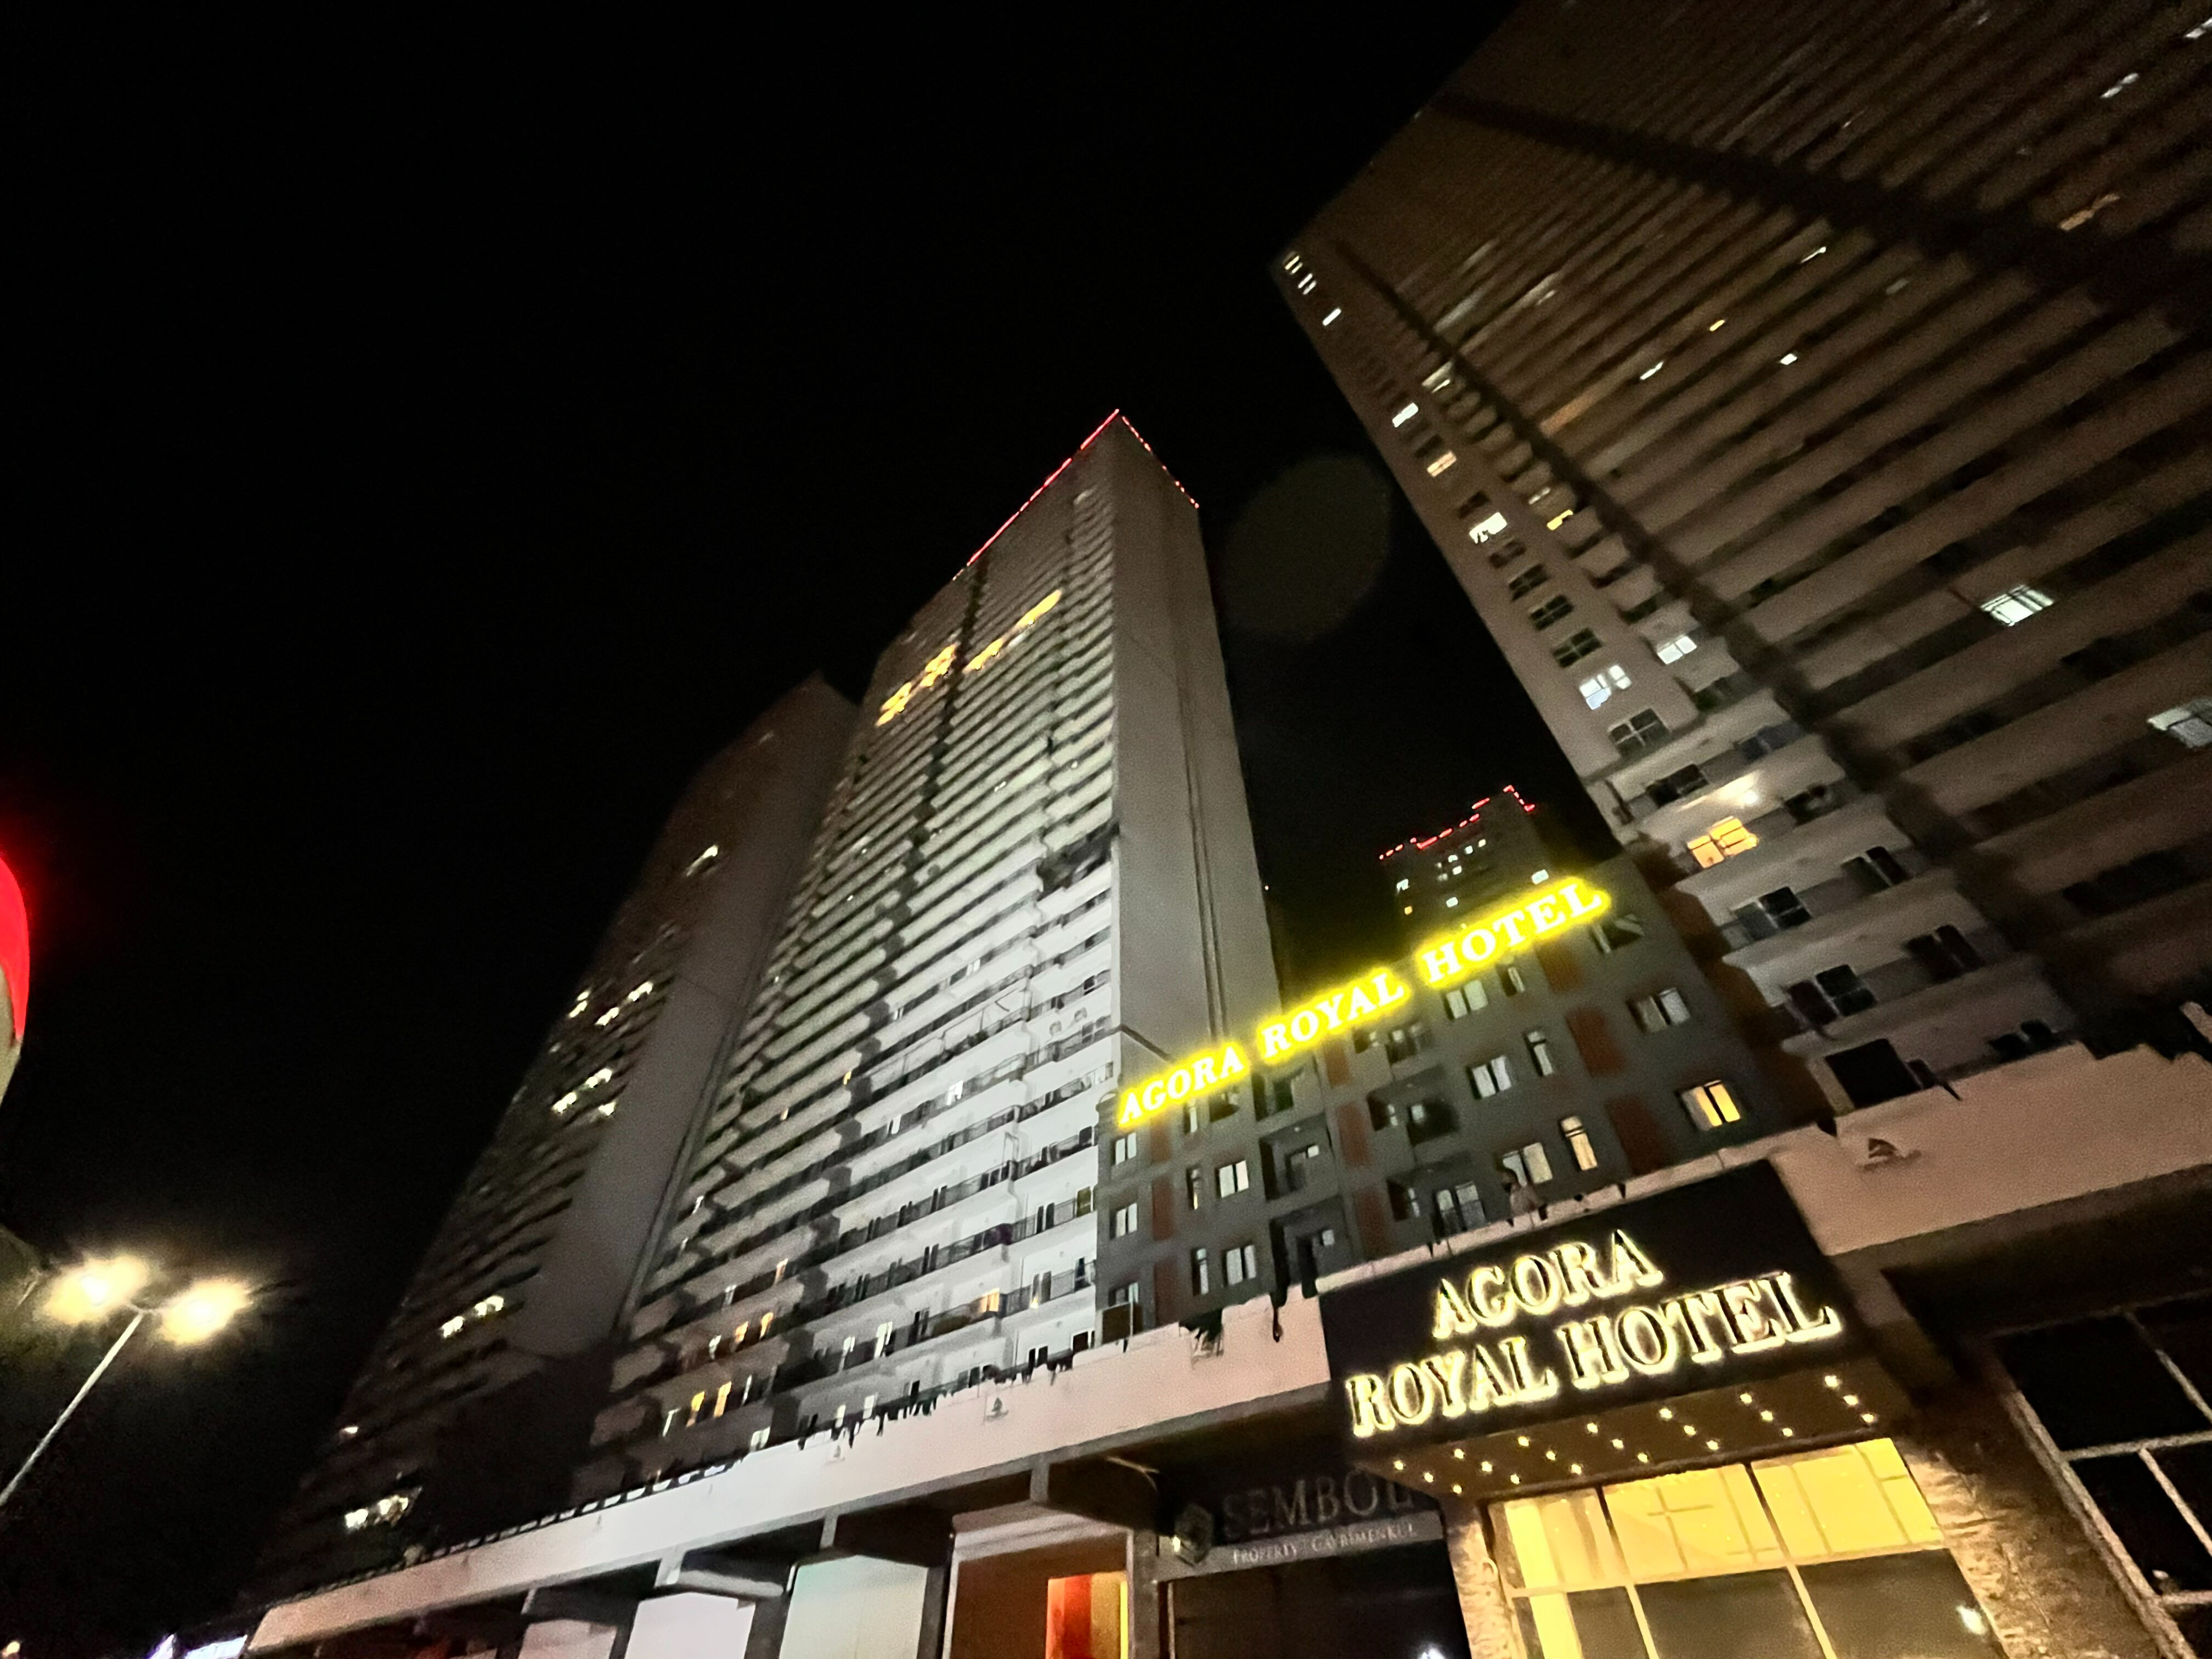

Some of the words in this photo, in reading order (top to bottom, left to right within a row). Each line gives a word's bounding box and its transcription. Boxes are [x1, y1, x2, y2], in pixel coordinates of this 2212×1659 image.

[1118, 1046, 1244, 1125] AGORA
[1261, 972, 1406, 1058] ROYAL
[1422, 880, 1603, 983] HOTEL
[1433, 1229, 1663, 1339] AGORA
[1345, 1336, 1558, 1437] ROYAL
[1557, 1271, 1841, 1388] HOTEL
[1223, 1468, 1413, 1538] SEMBOL
